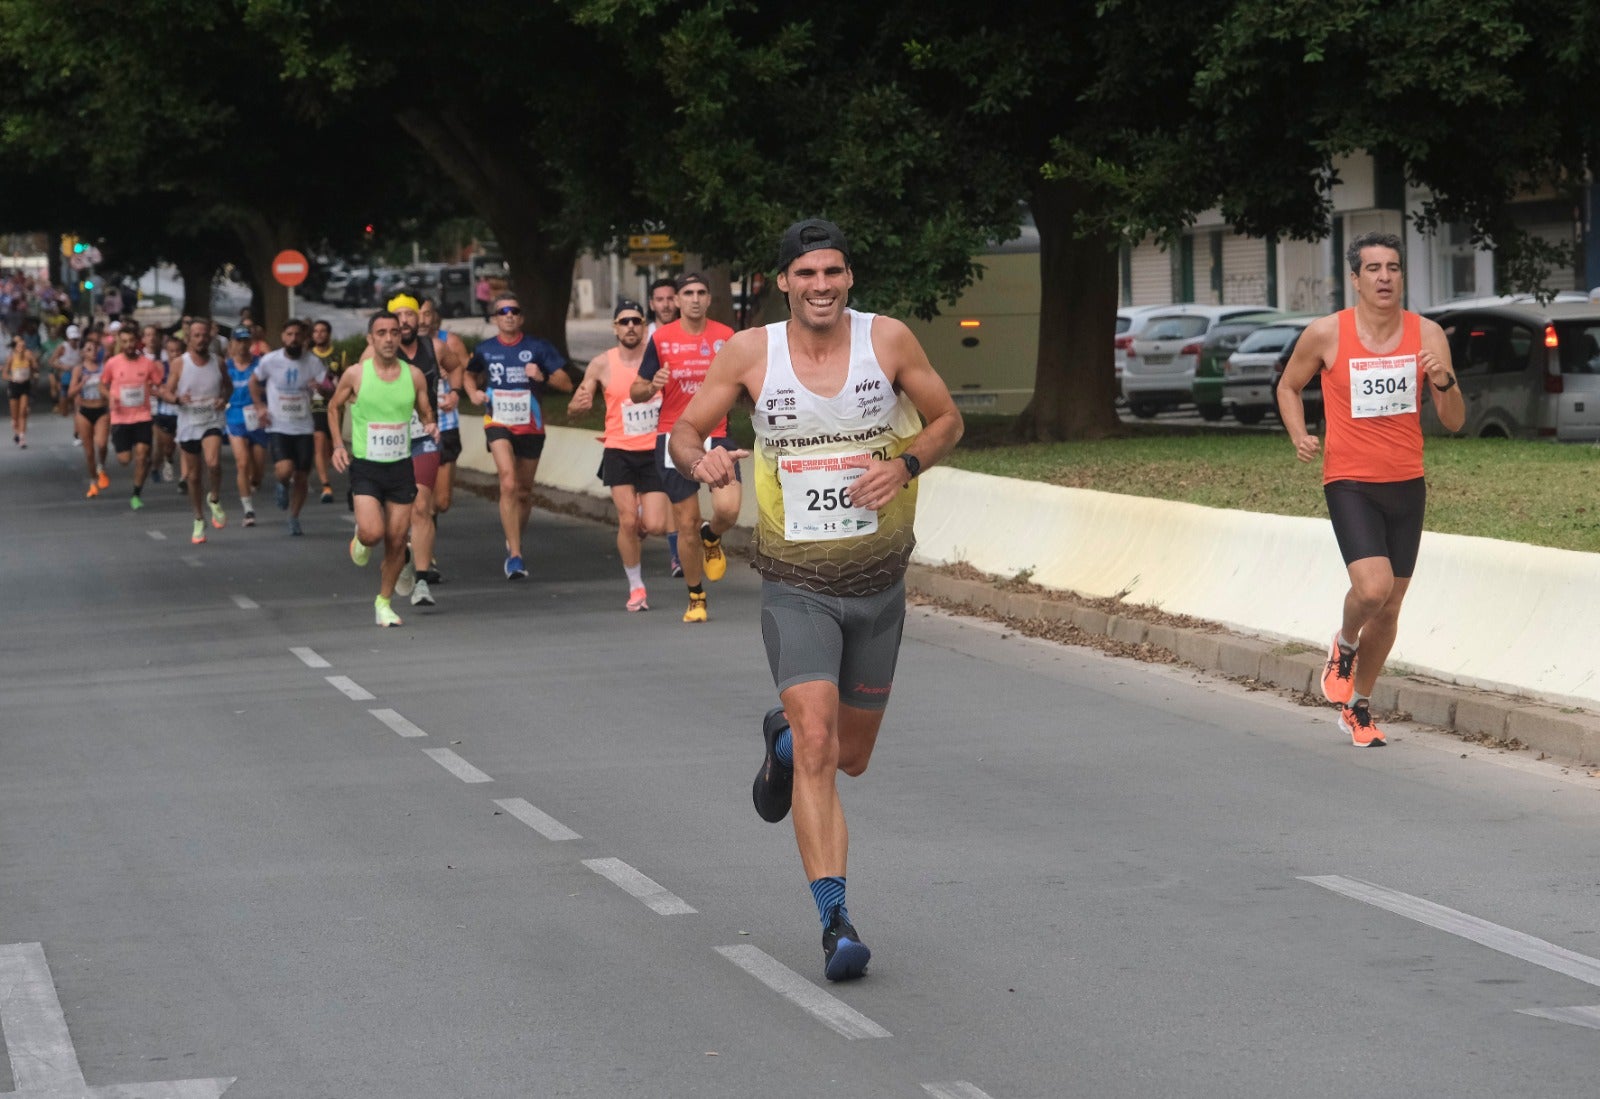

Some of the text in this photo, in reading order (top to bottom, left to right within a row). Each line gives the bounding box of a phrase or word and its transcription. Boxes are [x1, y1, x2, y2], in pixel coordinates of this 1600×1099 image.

[1352, 362, 1367, 370] 42
[1363, 377, 1407, 395] 3504
[497, 402, 527, 412] 13363
[372, 435, 405, 446] 11603
[790, 433, 852, 447] TRIATLÓN
[781, 460, 802, 473] 42
[803, 458, 838, 467] CARRERA
[806, 487, 852, 511] 256
